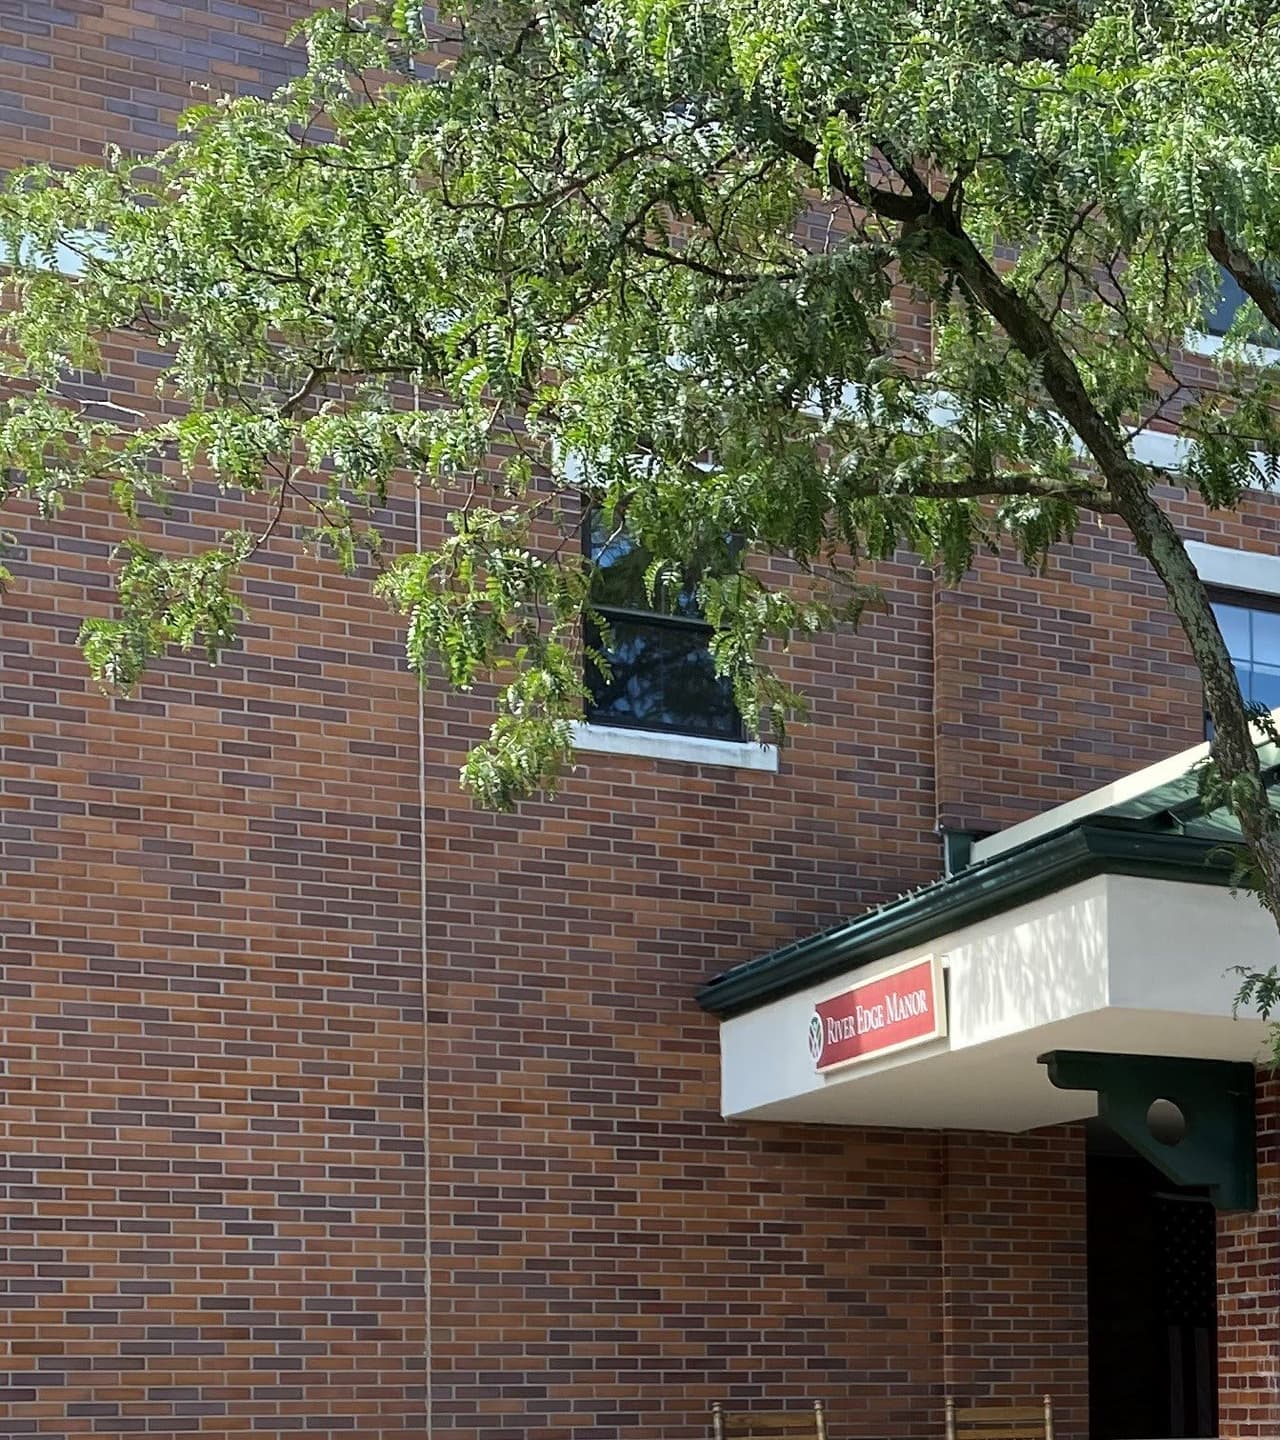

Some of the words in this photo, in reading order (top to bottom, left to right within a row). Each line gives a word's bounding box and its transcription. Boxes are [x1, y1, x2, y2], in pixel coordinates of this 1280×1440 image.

[826, 1016, 856, 1045] RIVER
[856, 1005, 885, 1034] EDGE
[885, 989, 928, 1025] MANOR
